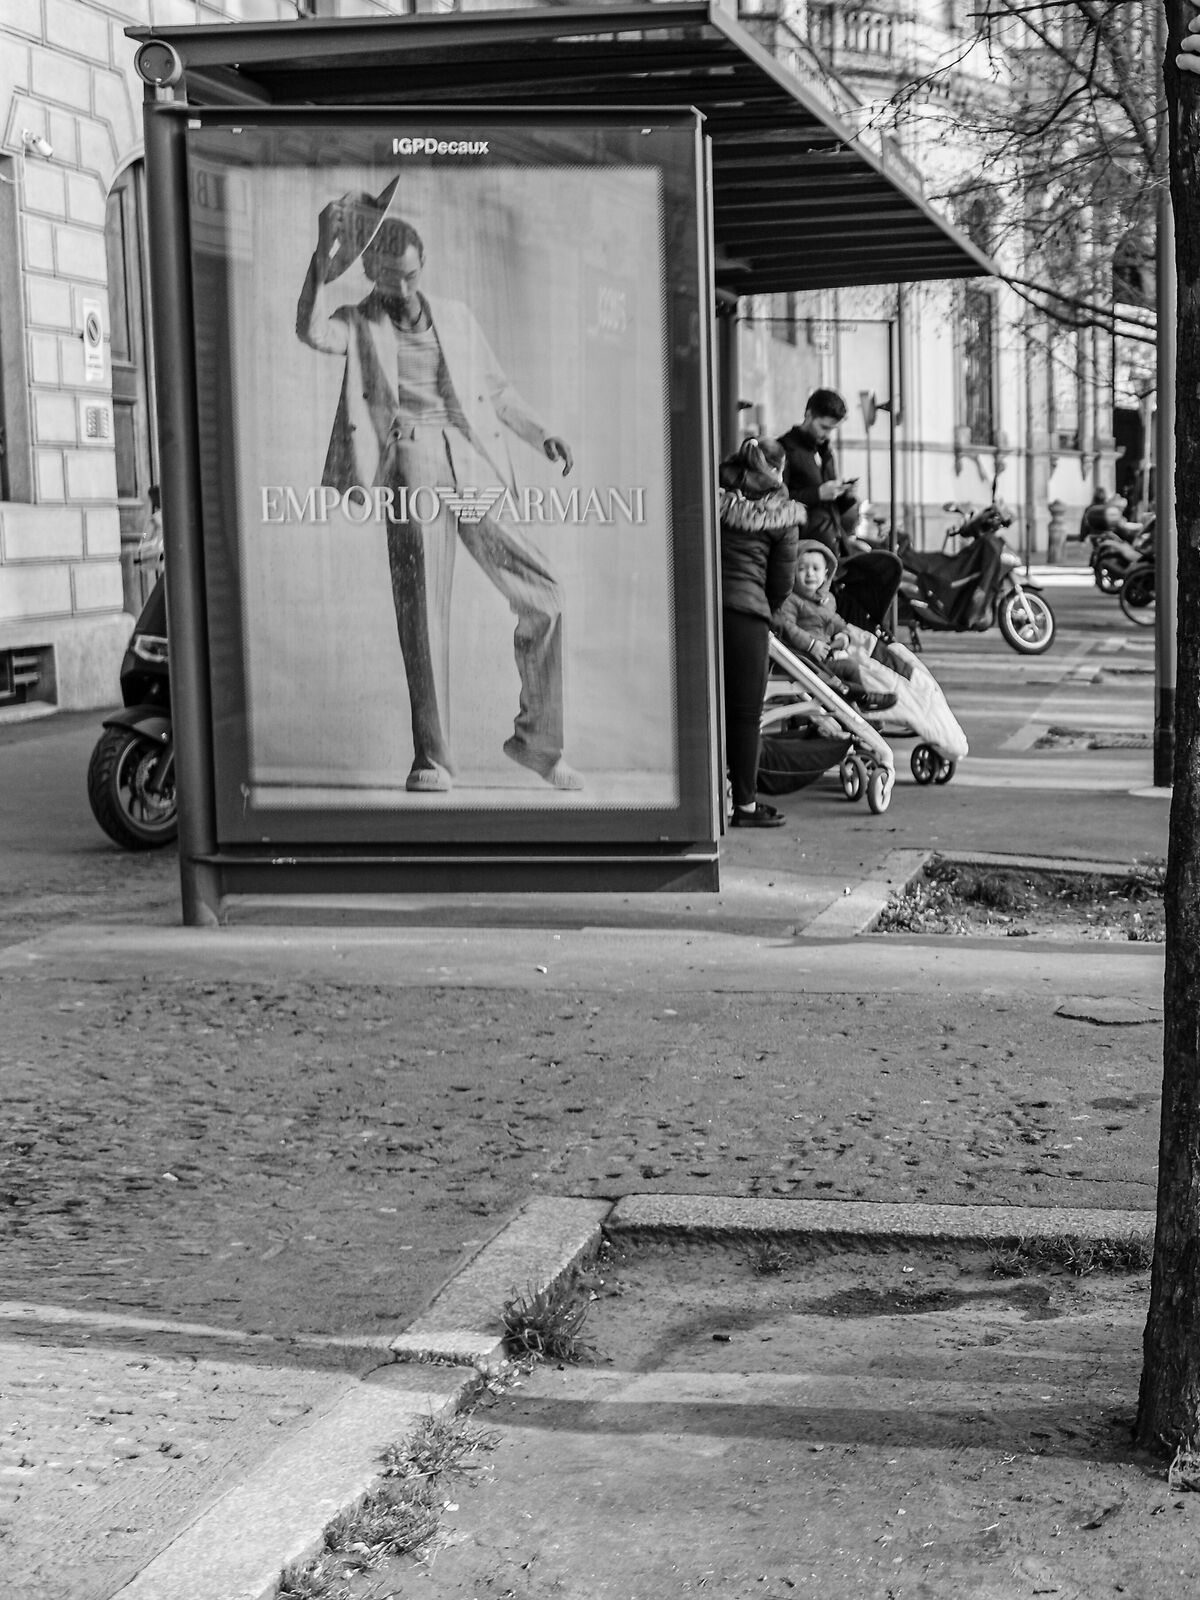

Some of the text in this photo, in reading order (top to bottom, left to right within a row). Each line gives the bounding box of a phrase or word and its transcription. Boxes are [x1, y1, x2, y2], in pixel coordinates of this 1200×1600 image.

[392, 137, 489, 155] IGPDecaux
[260, 485, 647, 524] EMPORIO ARMANI
